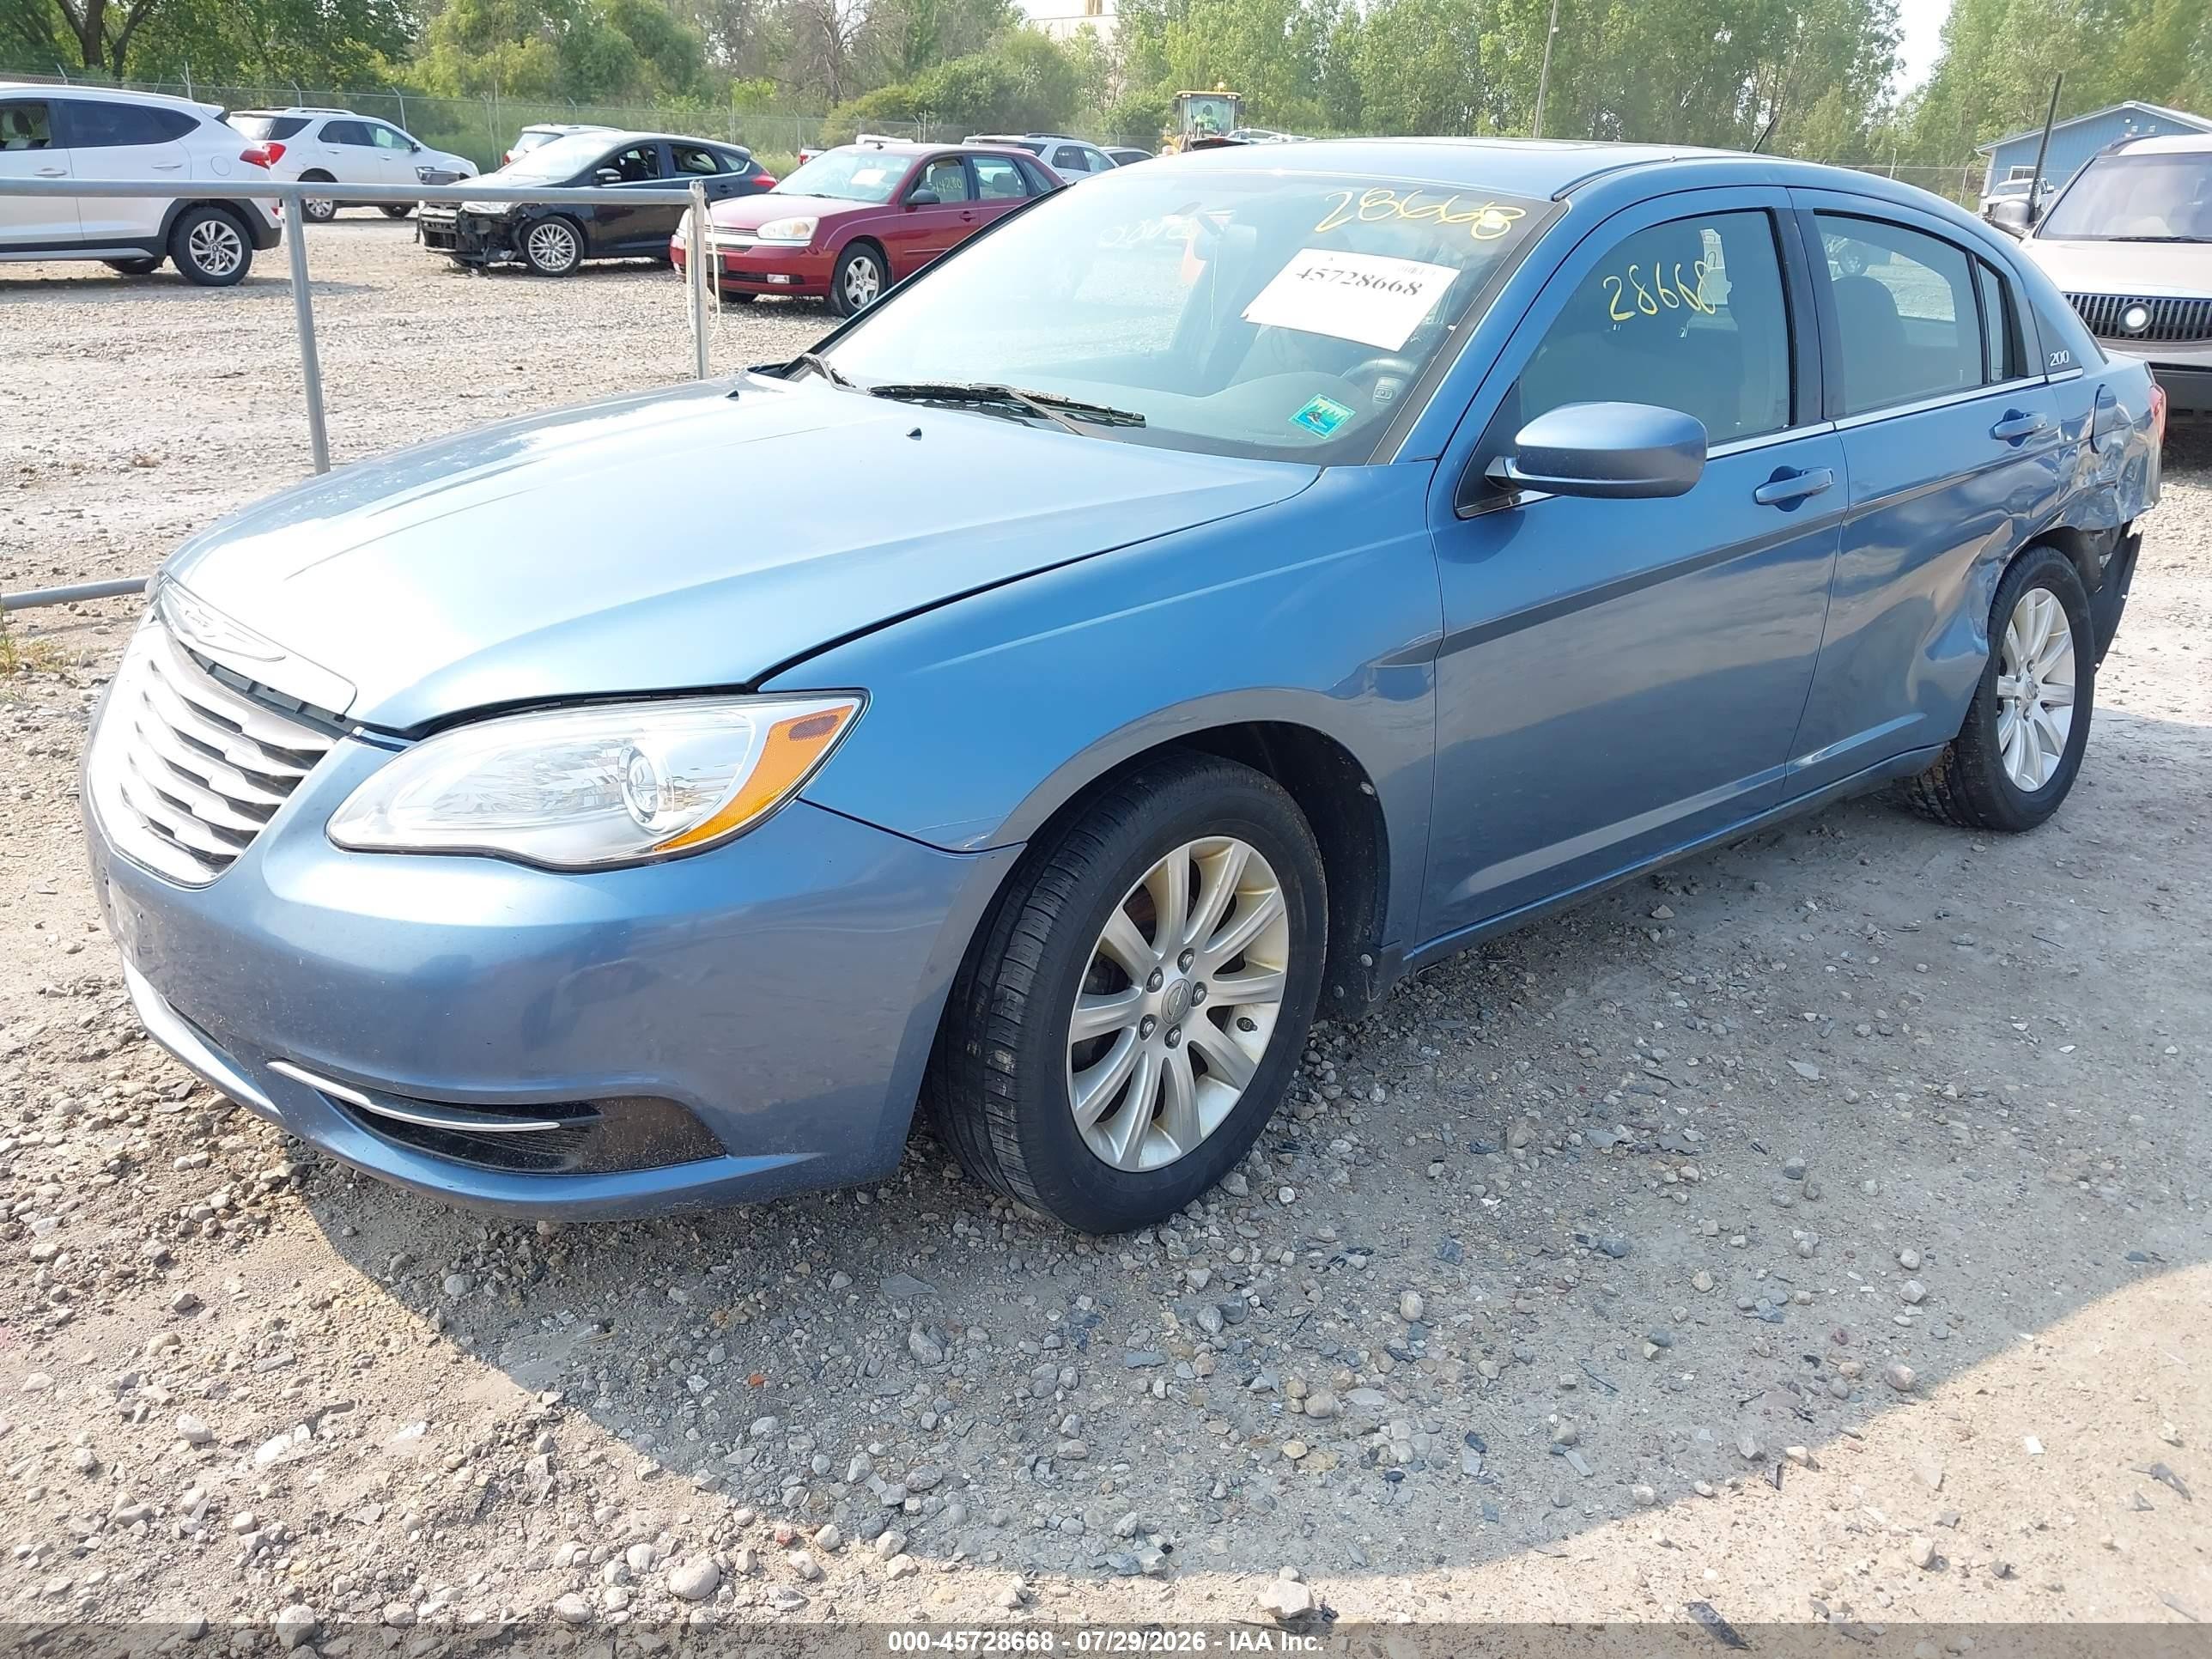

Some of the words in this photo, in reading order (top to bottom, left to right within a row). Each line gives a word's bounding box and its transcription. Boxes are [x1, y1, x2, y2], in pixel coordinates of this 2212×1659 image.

[1315, 186, 1527, 240] 28668
[1295, 266, 1424, 296] 45728668
[1602, 260, 1716, 321] 28668
[2049, 349, 2069, 367] 200
